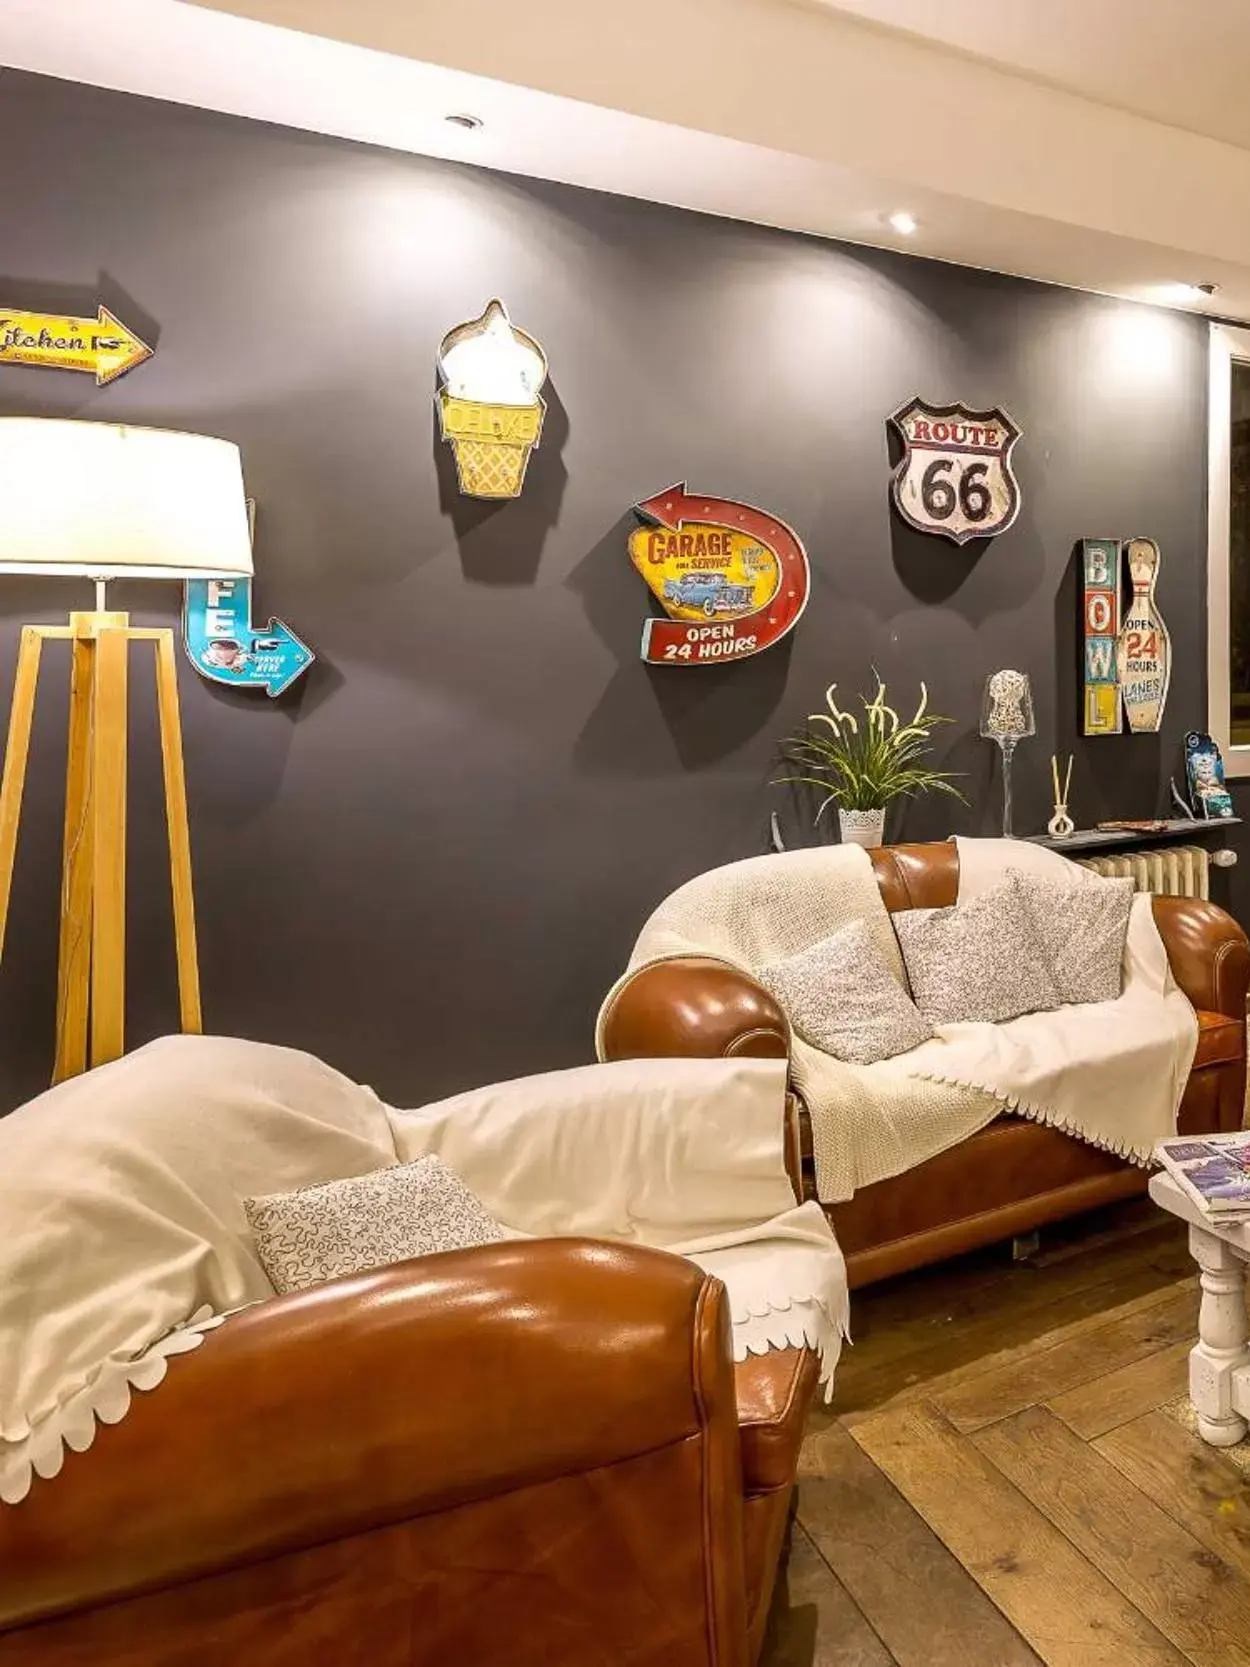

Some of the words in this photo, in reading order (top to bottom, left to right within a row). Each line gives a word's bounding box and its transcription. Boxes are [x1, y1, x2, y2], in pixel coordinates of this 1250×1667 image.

[913, 420, 999, 447] ROUTE
[922, 459, 992, 522] 66
[647, 532, 732, 564] GARAGE
[690, 556, 732, 569] SERVICE
[686, 623, 734, 643] OPEN
[1087, 547, 1112, 727] BOWL
[1126, 619, 1157, 631] OPEN
[664, 644, 692, 660] 24
[698, 635, 757, 658] HOURS
[1126, 631, 1158, 660] 24
[1126, 661, 1157, 673] HOURS
[1124, 678, 1160, 698] LANES
